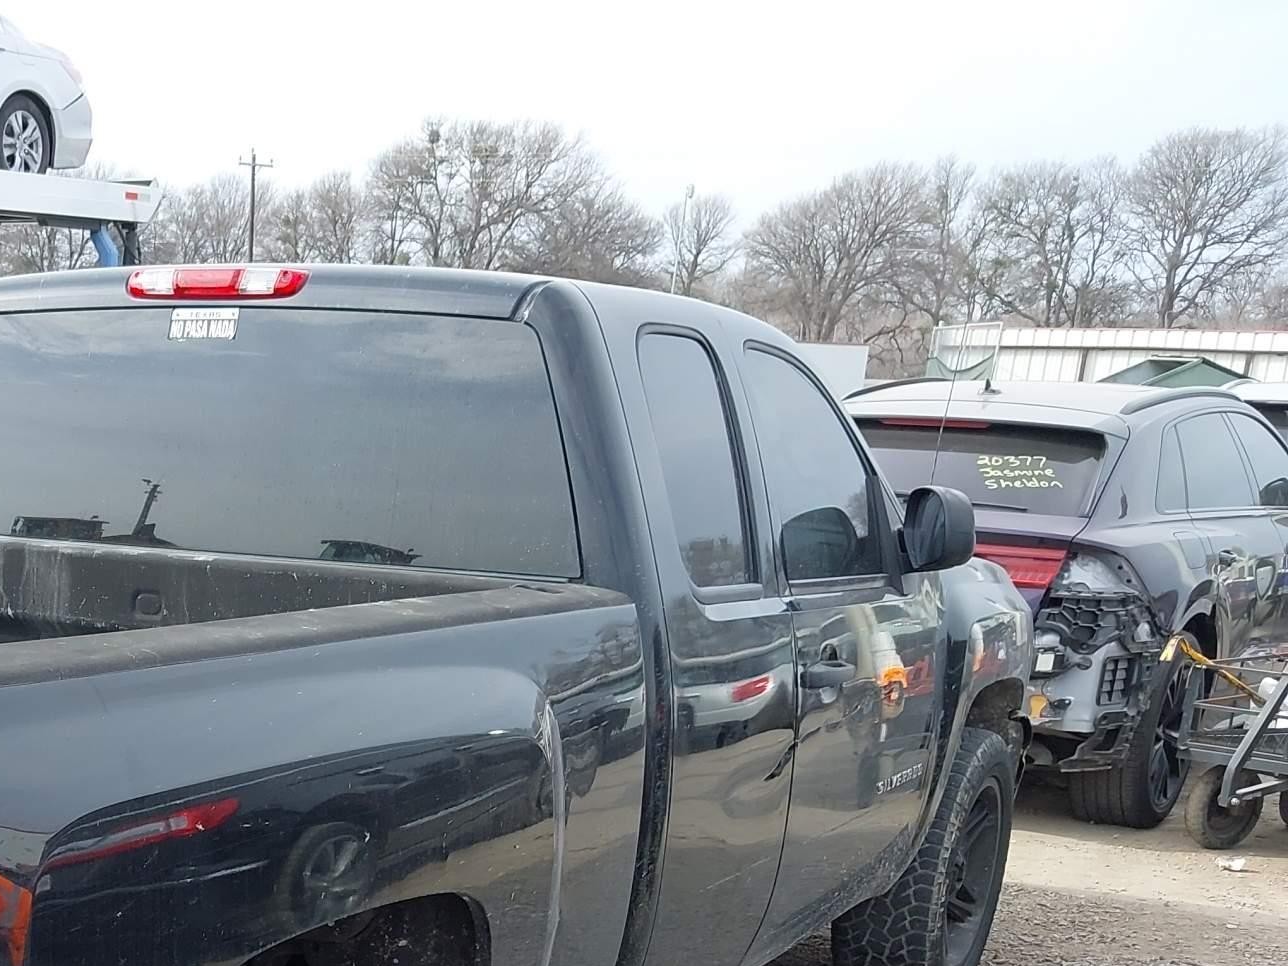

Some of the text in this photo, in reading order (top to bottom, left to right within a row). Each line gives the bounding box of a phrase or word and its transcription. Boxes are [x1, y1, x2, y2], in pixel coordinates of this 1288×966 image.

[169, 319, 235, 340] NO PASA NADA
[977, 455, 1047, 466] 20377
[979, 467, 1056, 478] Jasmine
[984, 478, 1064, 489] Sheldon
